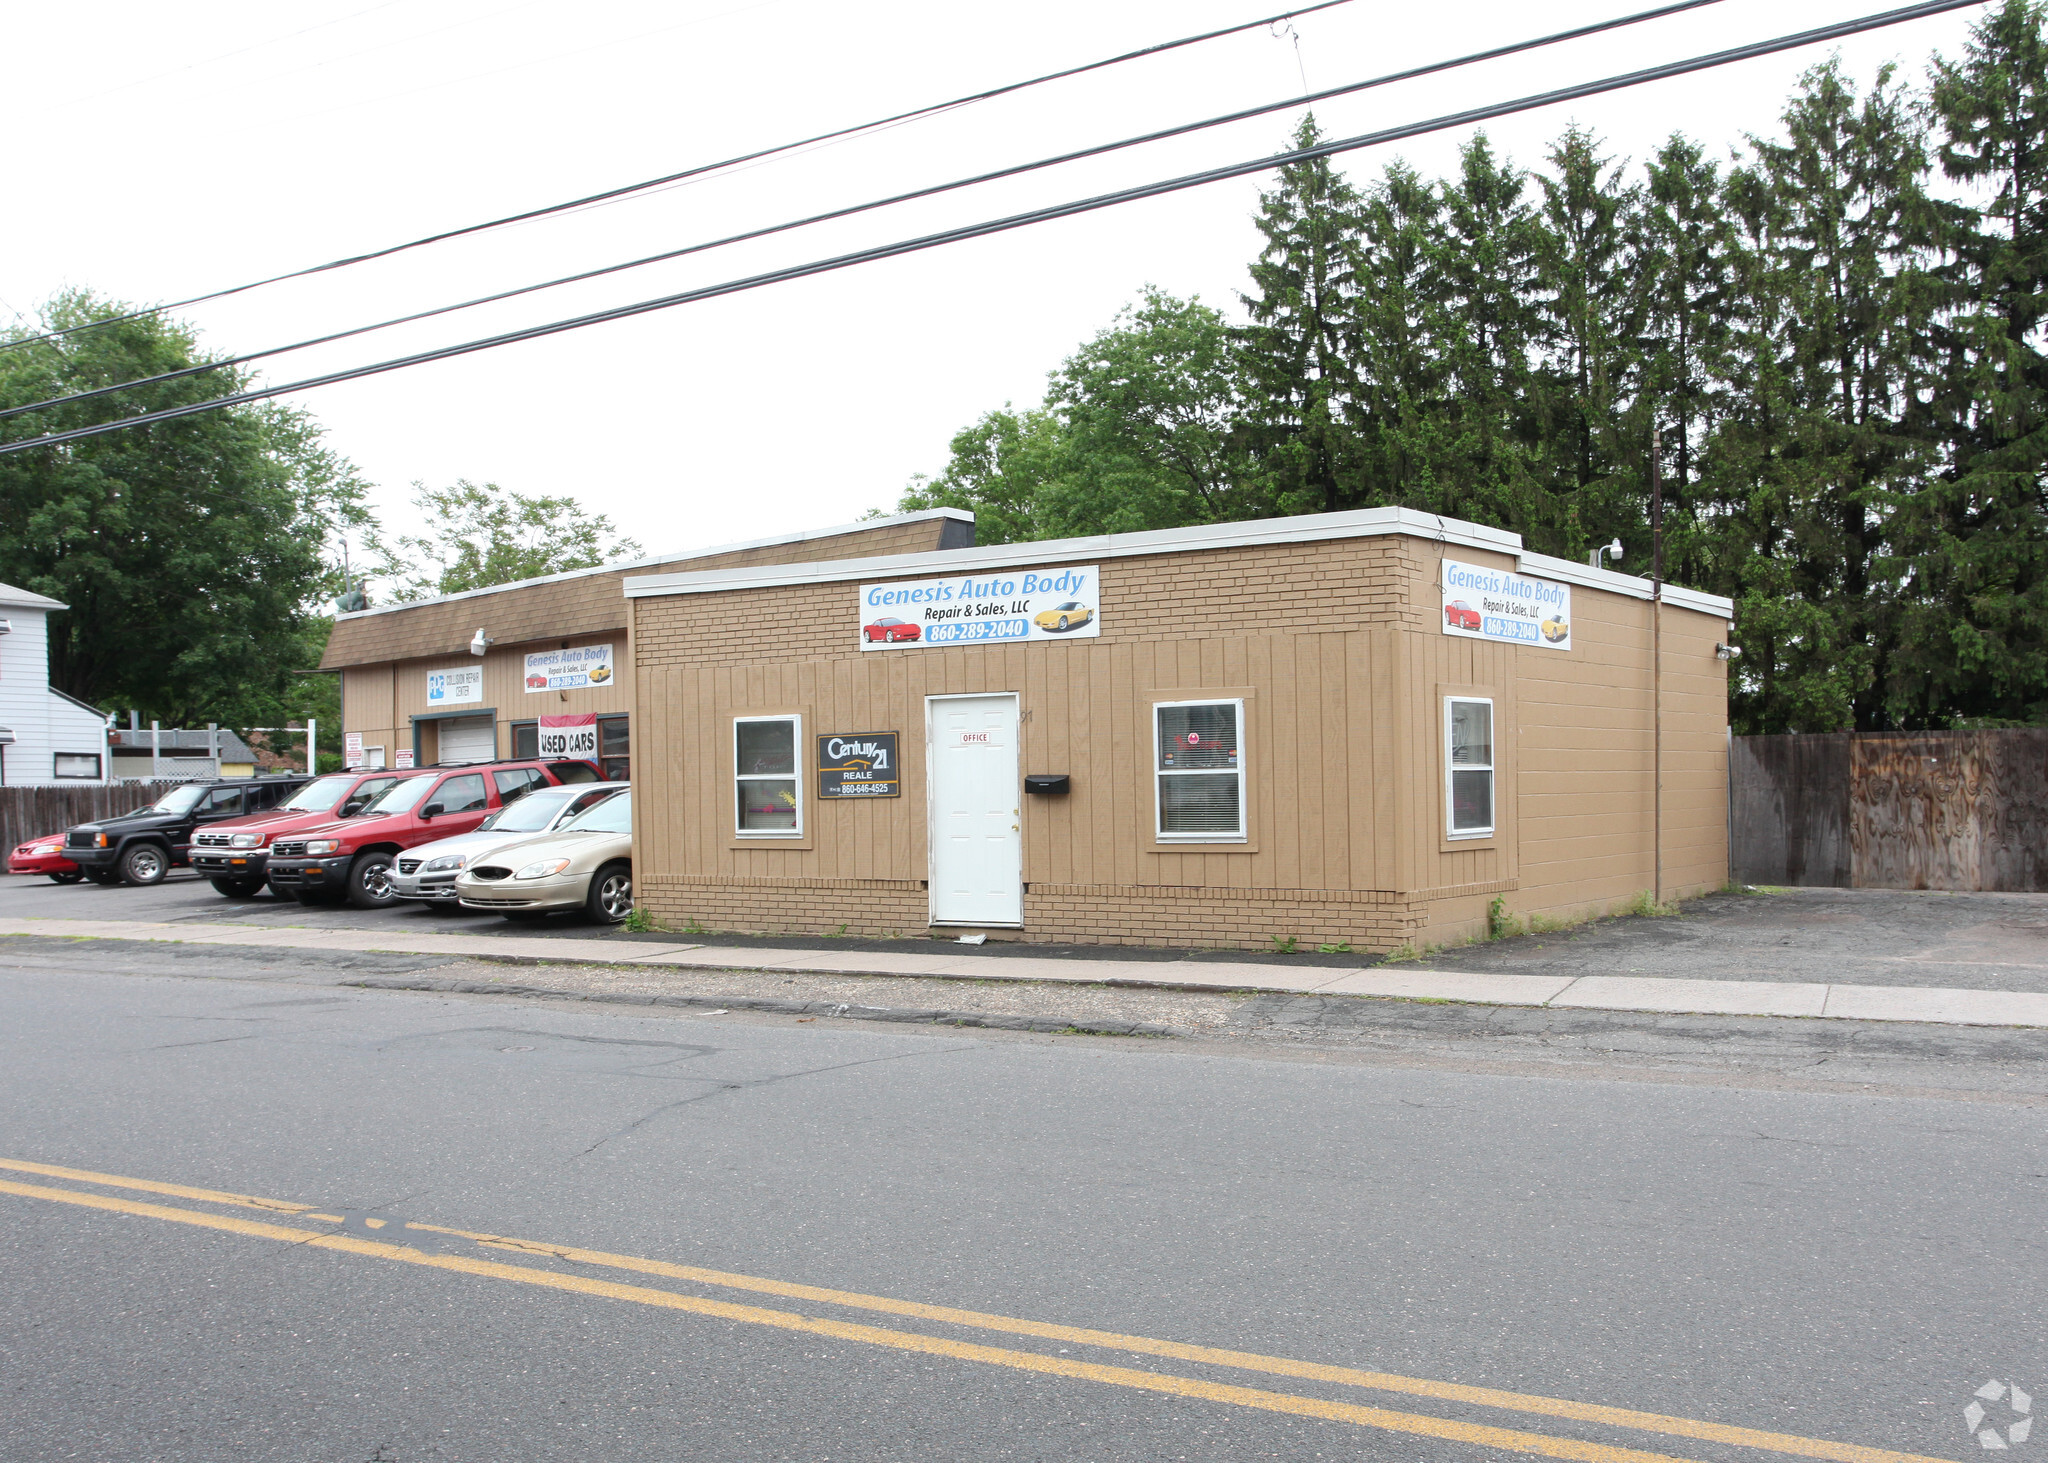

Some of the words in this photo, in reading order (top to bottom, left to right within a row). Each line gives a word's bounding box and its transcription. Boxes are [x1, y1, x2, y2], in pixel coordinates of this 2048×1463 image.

[867, 580, 954, 607] Genesis
[958, 578, 1016, 600] Auto
[1021, 570, 1086, 597] Body
[1447, 564, 1500, 593] Genesis
[1502, 575, 1532, 599] Auto
[1534, 581, 1565, 609] Body
[924, 604, 963, 622] Repair
[963, 604, 973, 617] &
[975, 601, 1008, 617] Sales,
[1011, 599, 1031, 613] LLC
[1482, 597, 1504, 615] Repair
[1505, 601, 1510, 613] &
[1511, 601, 1529, 618] Sales,
[1529, 605, 1540, 618] LLC
[929, 619, 1025, 642] 860-289-2040
[1486, 616, 1537, 640] 860-289-2040
[527, 652, 560, 667] Genesis
[561, 650, 582, 663] Auto
[584, 646, 608, 662] Body
[465, 671, 479, 683] REPAIR
[548, 665, 562, 676] Repair
[430, 677, 444, 697] PPG
[455, 685, 469, 697] CENTER
[550, 675, 586, 687] 860-289-2040
[1020, 709, 1033, 724] 91
[541, 734, 567, 753] USED
[569, 731, 594, 752] CARS
[962, 733, 987, 742] OFFICE
[827, 737, 877, 759] Century
[872, 748, 888, 769] 21
[843, 771, 873, 780] REALE
[841, 783, 888, 794] 860-646-4525
